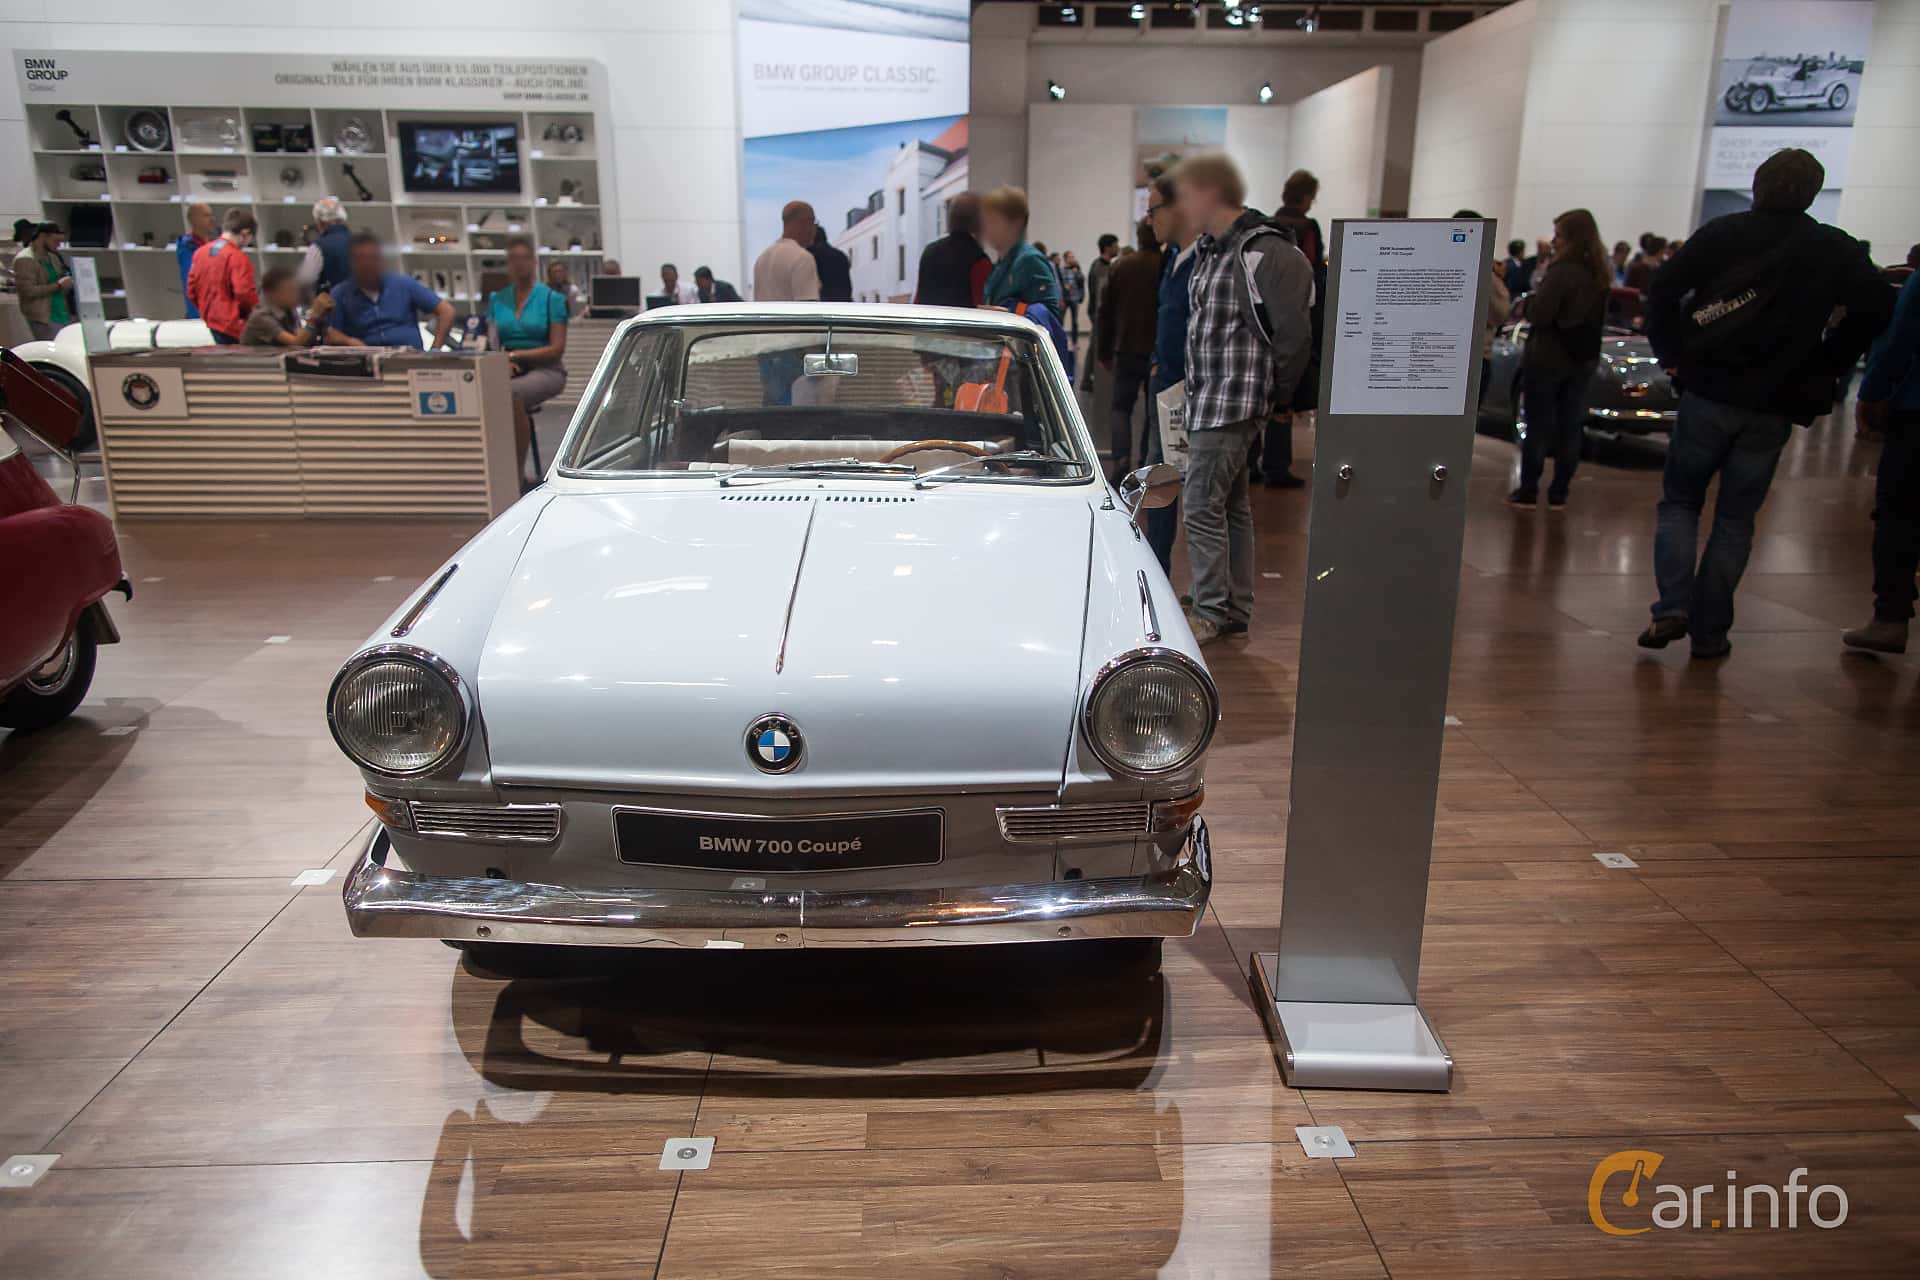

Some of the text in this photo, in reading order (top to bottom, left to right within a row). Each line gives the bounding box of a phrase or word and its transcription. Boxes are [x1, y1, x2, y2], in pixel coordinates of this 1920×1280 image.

[24, 59, 56, 69] BMW
[26, 70, 69, 81] GROUP
[753, 63, 796, 81] BMW
[799, 64, 859, 82] GROUP
[699, 836, 863, 855] BMW 700 Coupé
